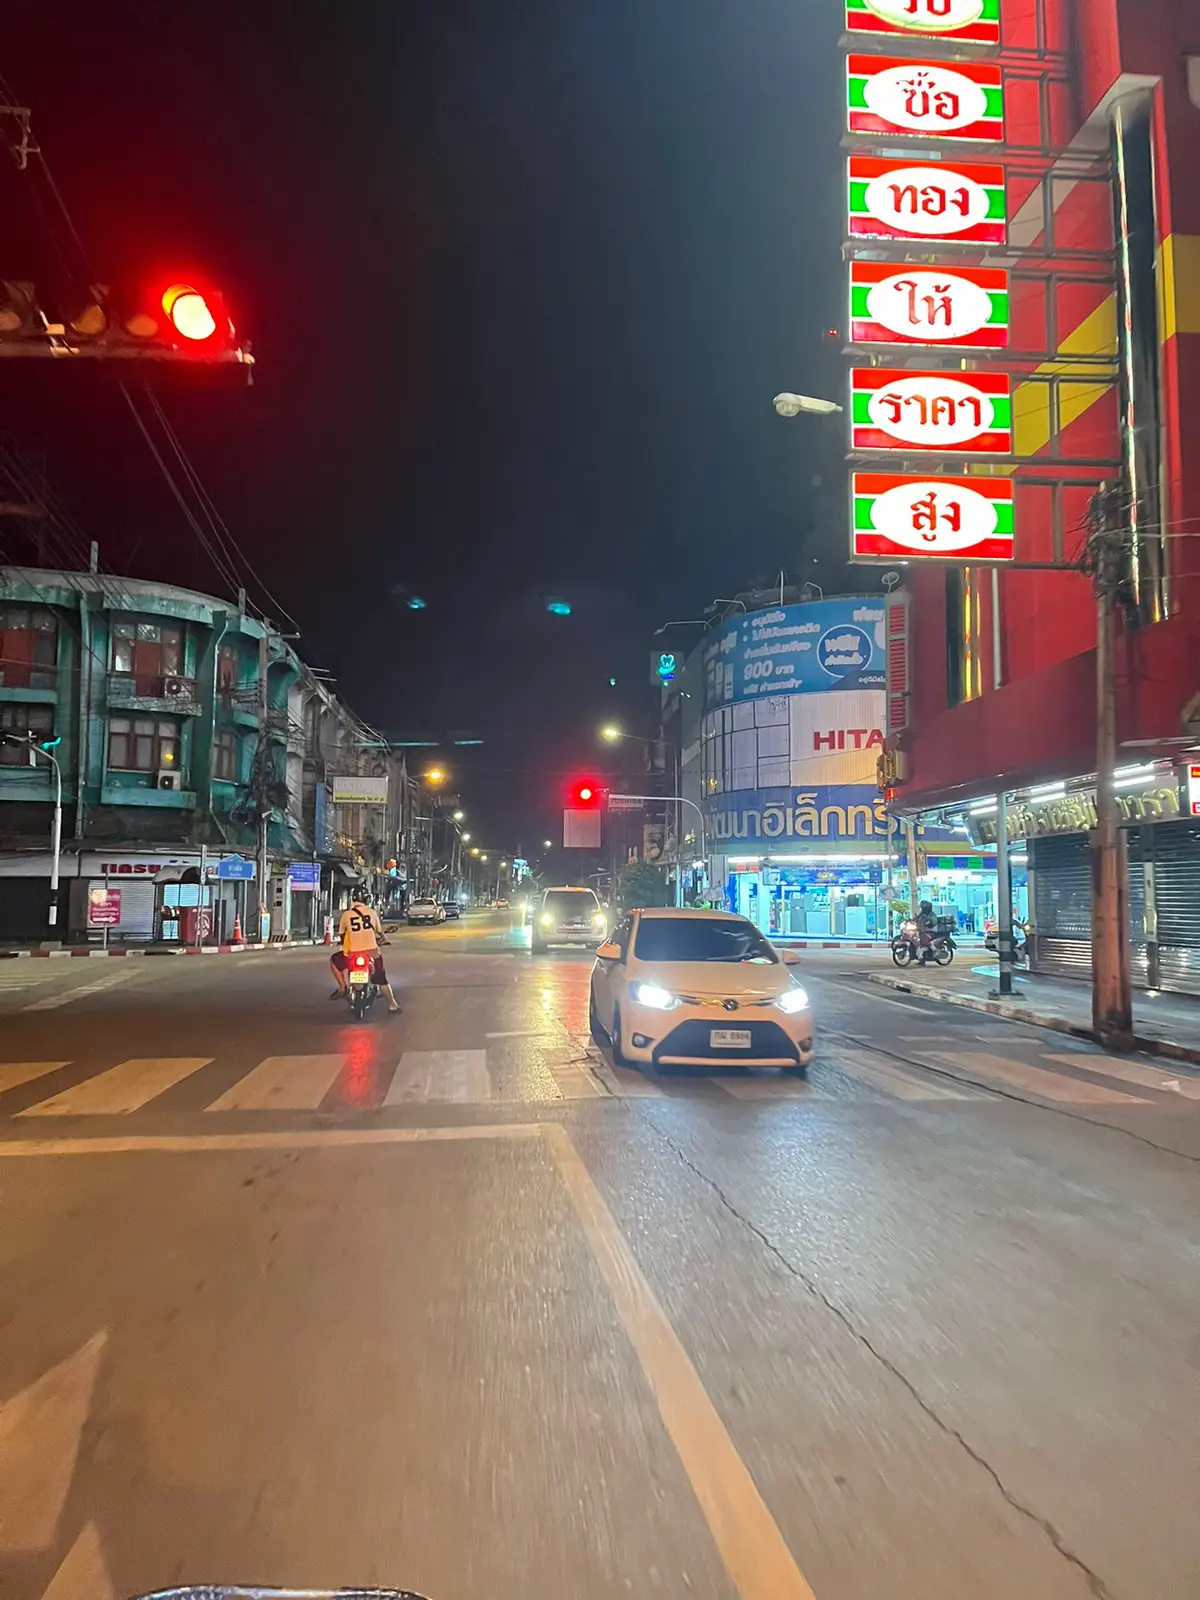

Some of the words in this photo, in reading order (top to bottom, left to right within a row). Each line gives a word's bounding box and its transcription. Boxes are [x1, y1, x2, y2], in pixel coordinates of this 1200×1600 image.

[896, 71, 960, 121] ซื้อ
[887, 183, 970, 217] ทอง
[894, 279, 953, 327] ให้
[878, 393, 982, 427] ราคา
[910, 491, 961, 542] สูง
[813, 728, 885, 751] HITA
[350, 914, 372, 931] 58
